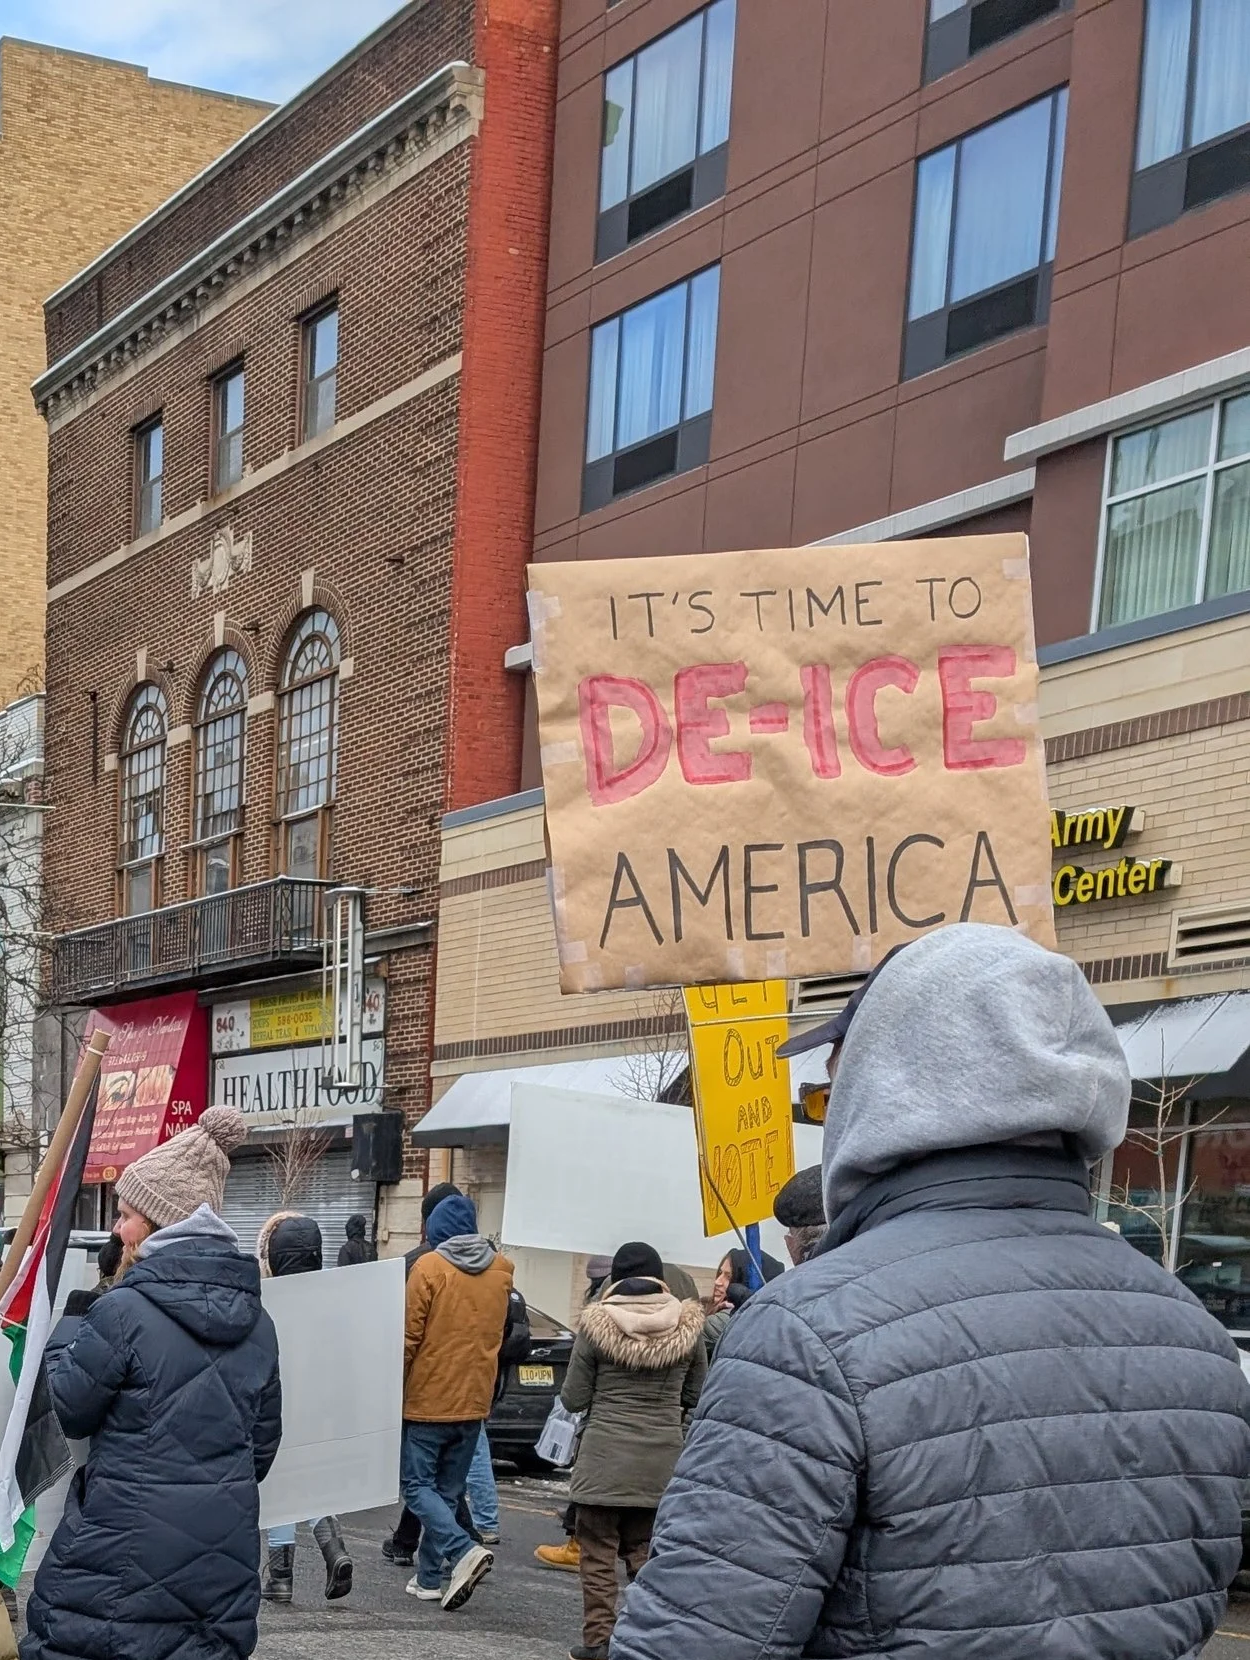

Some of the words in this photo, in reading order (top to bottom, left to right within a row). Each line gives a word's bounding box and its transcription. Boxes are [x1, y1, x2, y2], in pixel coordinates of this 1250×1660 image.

[609, 590, 715, 640] IT'S
[740, 581, 883, 633] TIME
[916, 577, 982, 622] TO
[577, 645, 1027, 807] DE-ICE
[1050, 806, 1128, 849] Army
[600, 831, 1020, 949] AMERICA
[1054, 858, 1163, 906] Center
[171, 1100, 192, 1115] SPA
[223, 1068, 308, 1113] HEALTH
[313, 1061, 378, 1107] FOOD
[737, 1096, 773, 1132] AND
